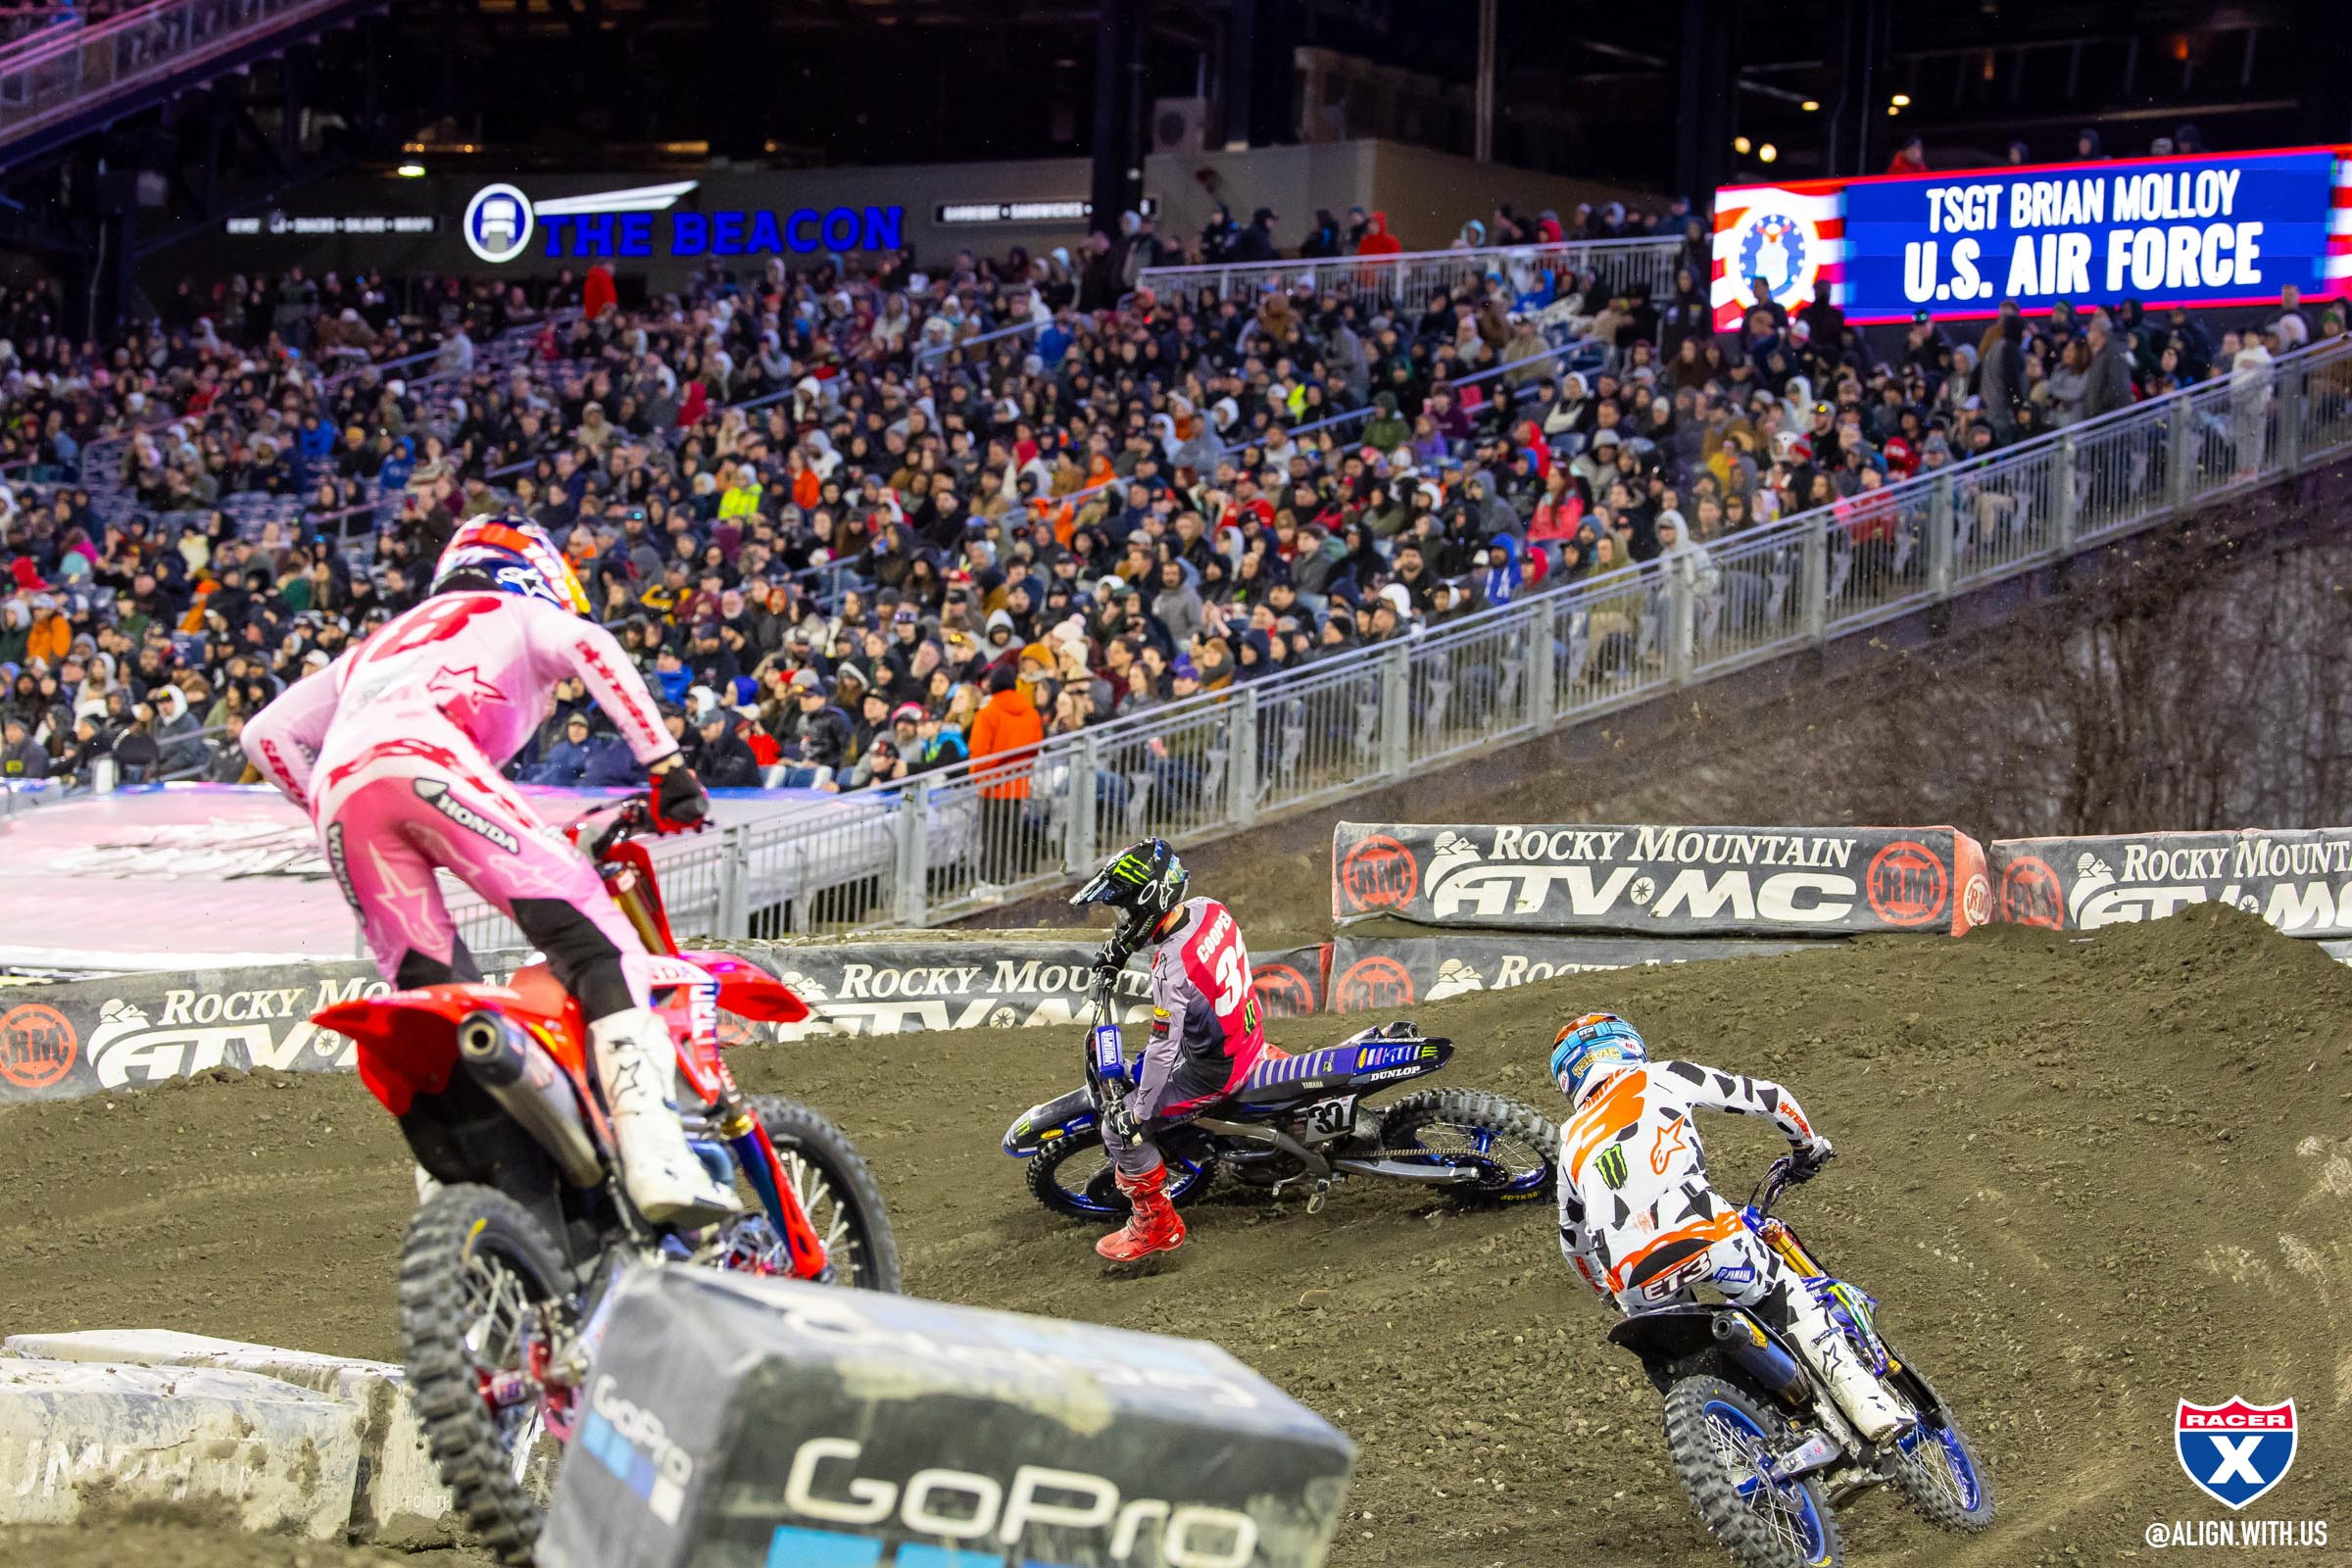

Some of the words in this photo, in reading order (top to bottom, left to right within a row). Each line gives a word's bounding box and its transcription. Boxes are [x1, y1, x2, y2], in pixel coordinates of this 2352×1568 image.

[1927, 183, 2003, 234] TSGT
[2010, 177, 2107, 228] BRIAN
[2113, 169, 2241, 223] MOLLOY
[539, 212, 654, 258] THE
[671, 206, 904, 257] BEACON
[1903, 240, 1994, 303] U.S.
[2006, 230, 2092, 296] AIR
[2106, 220, 2265, 292] FORCE
[436, 793, 520, 855] HONDA
[1489, 825, 1618, 862] ROCKY
[1627, 826, 1857, 868] MOUNTAIN
[2121, 843, 2230, 883] ROCKY
[2233, 838, 2352, 879] MOUNT
[834, 963, 983, 1000] ROCKY
[157, 988, 306, 1027] ROCKY
[1301, 1080, 1324, 1090] YAMAHA
[1370, 1065, 1422, 1082] DUNLOP
[1307, 1102, 1356, 1135] 32
[1643, 1253, 1711, 1301] ET3
[1726, 1268, 1752, 1283] YAMAHA
[593, 1374, 693, 1487] GoPro
[785, 1437, 1257, 1568] GoPro
